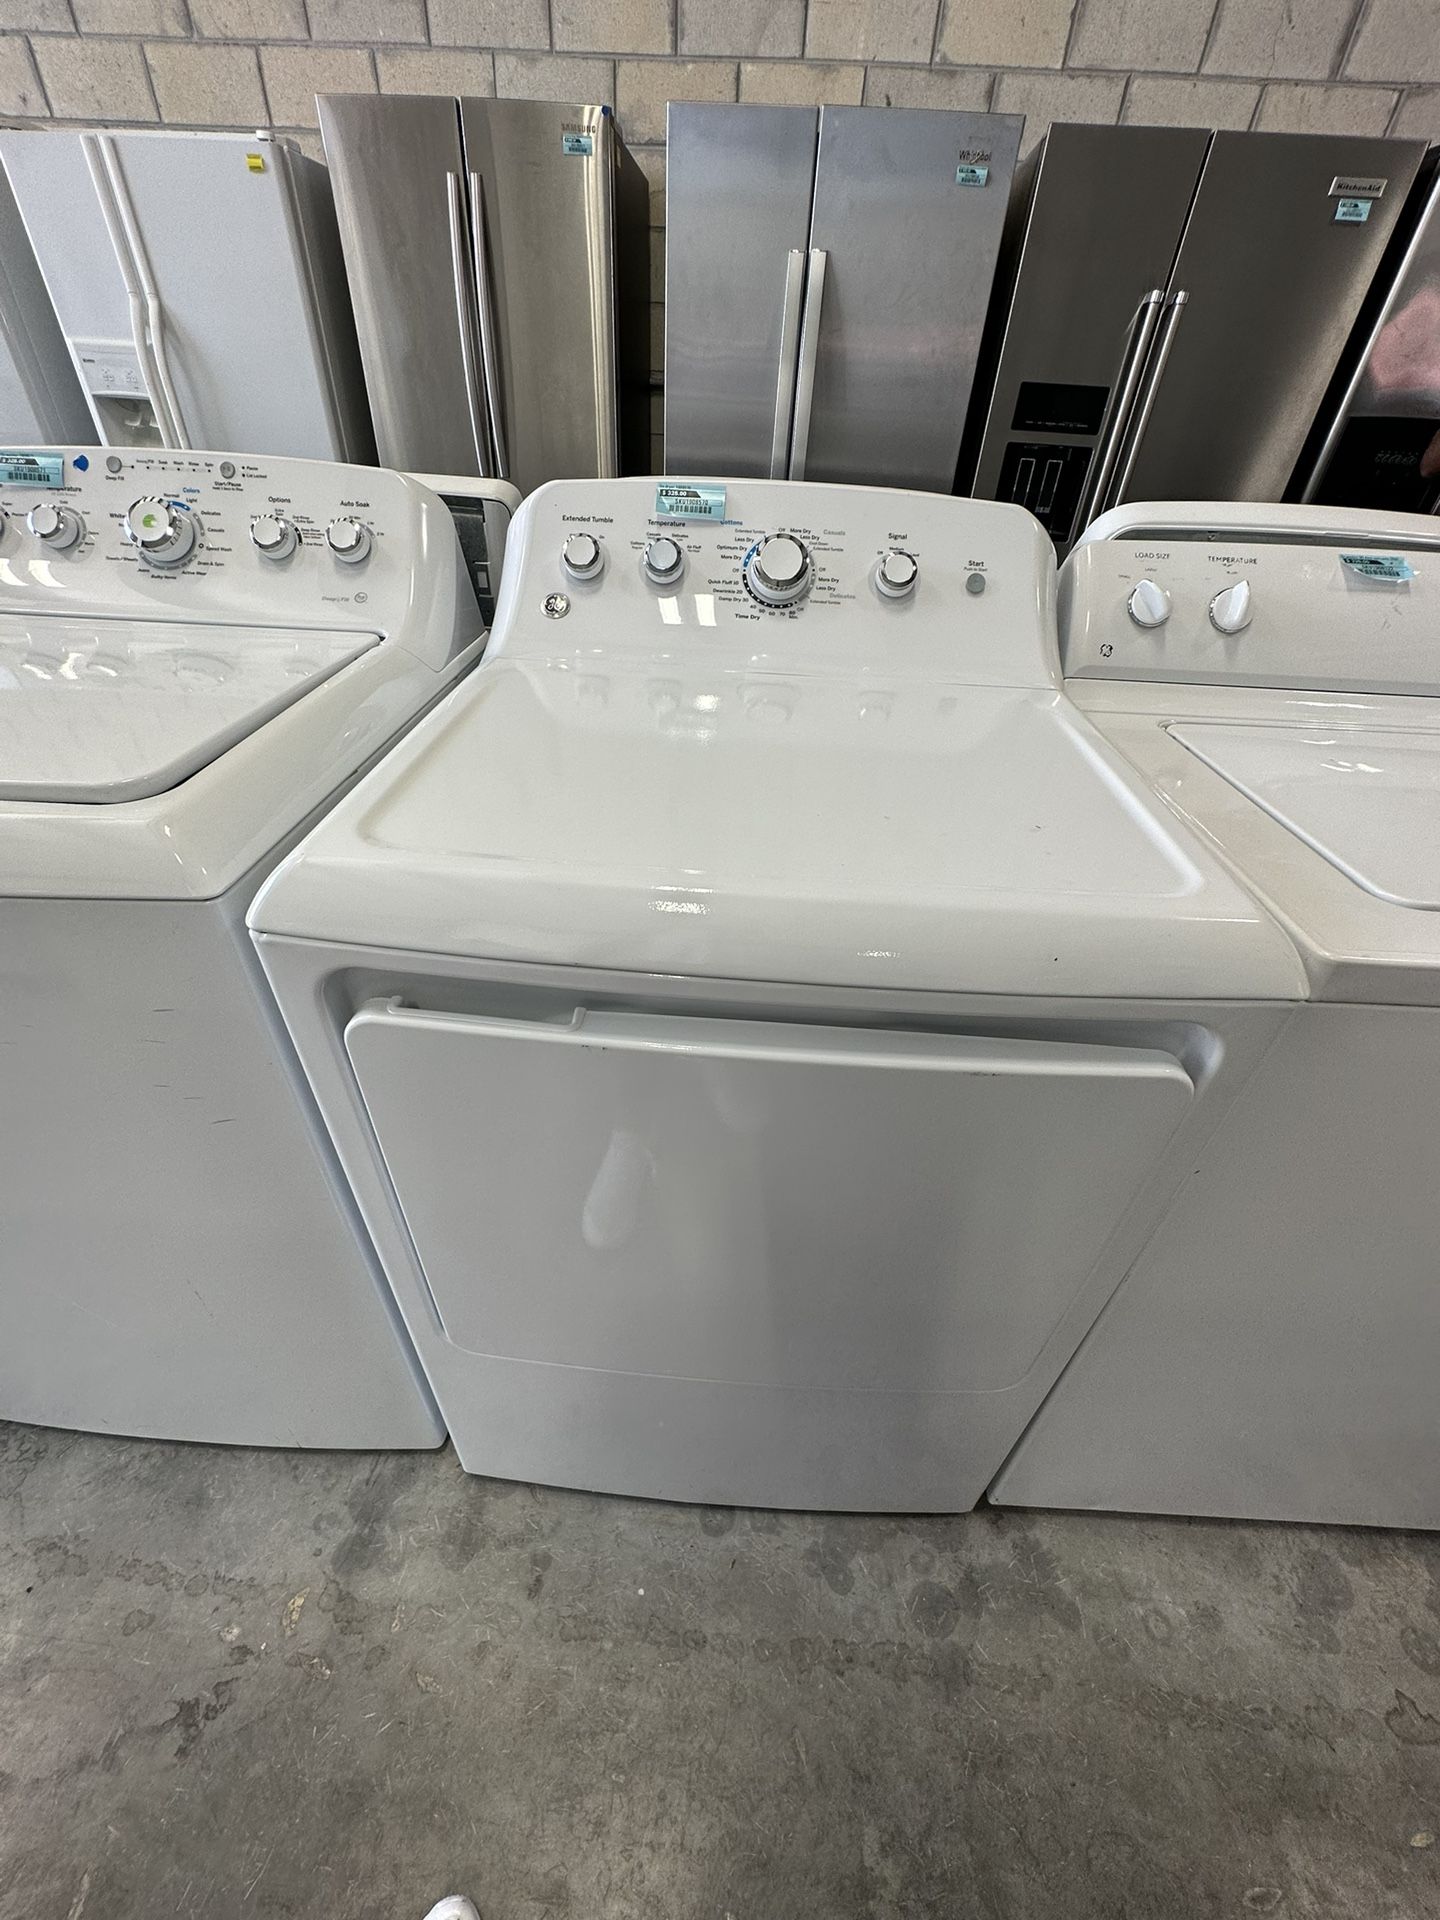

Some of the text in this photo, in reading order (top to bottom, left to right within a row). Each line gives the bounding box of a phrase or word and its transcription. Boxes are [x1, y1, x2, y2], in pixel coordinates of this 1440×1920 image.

[561, 123, 596, 133] SAMSUNG
[1337, 183, 1381, 192] KitchenAid
[268, 496, 291, 504] Options
[562, 515, 591, 523] Extended
[648, 519, 687, 527] Temperature
[969, 560, 985, 568] Start
[1208, 555, 1258, 565] TEMPERATURE
